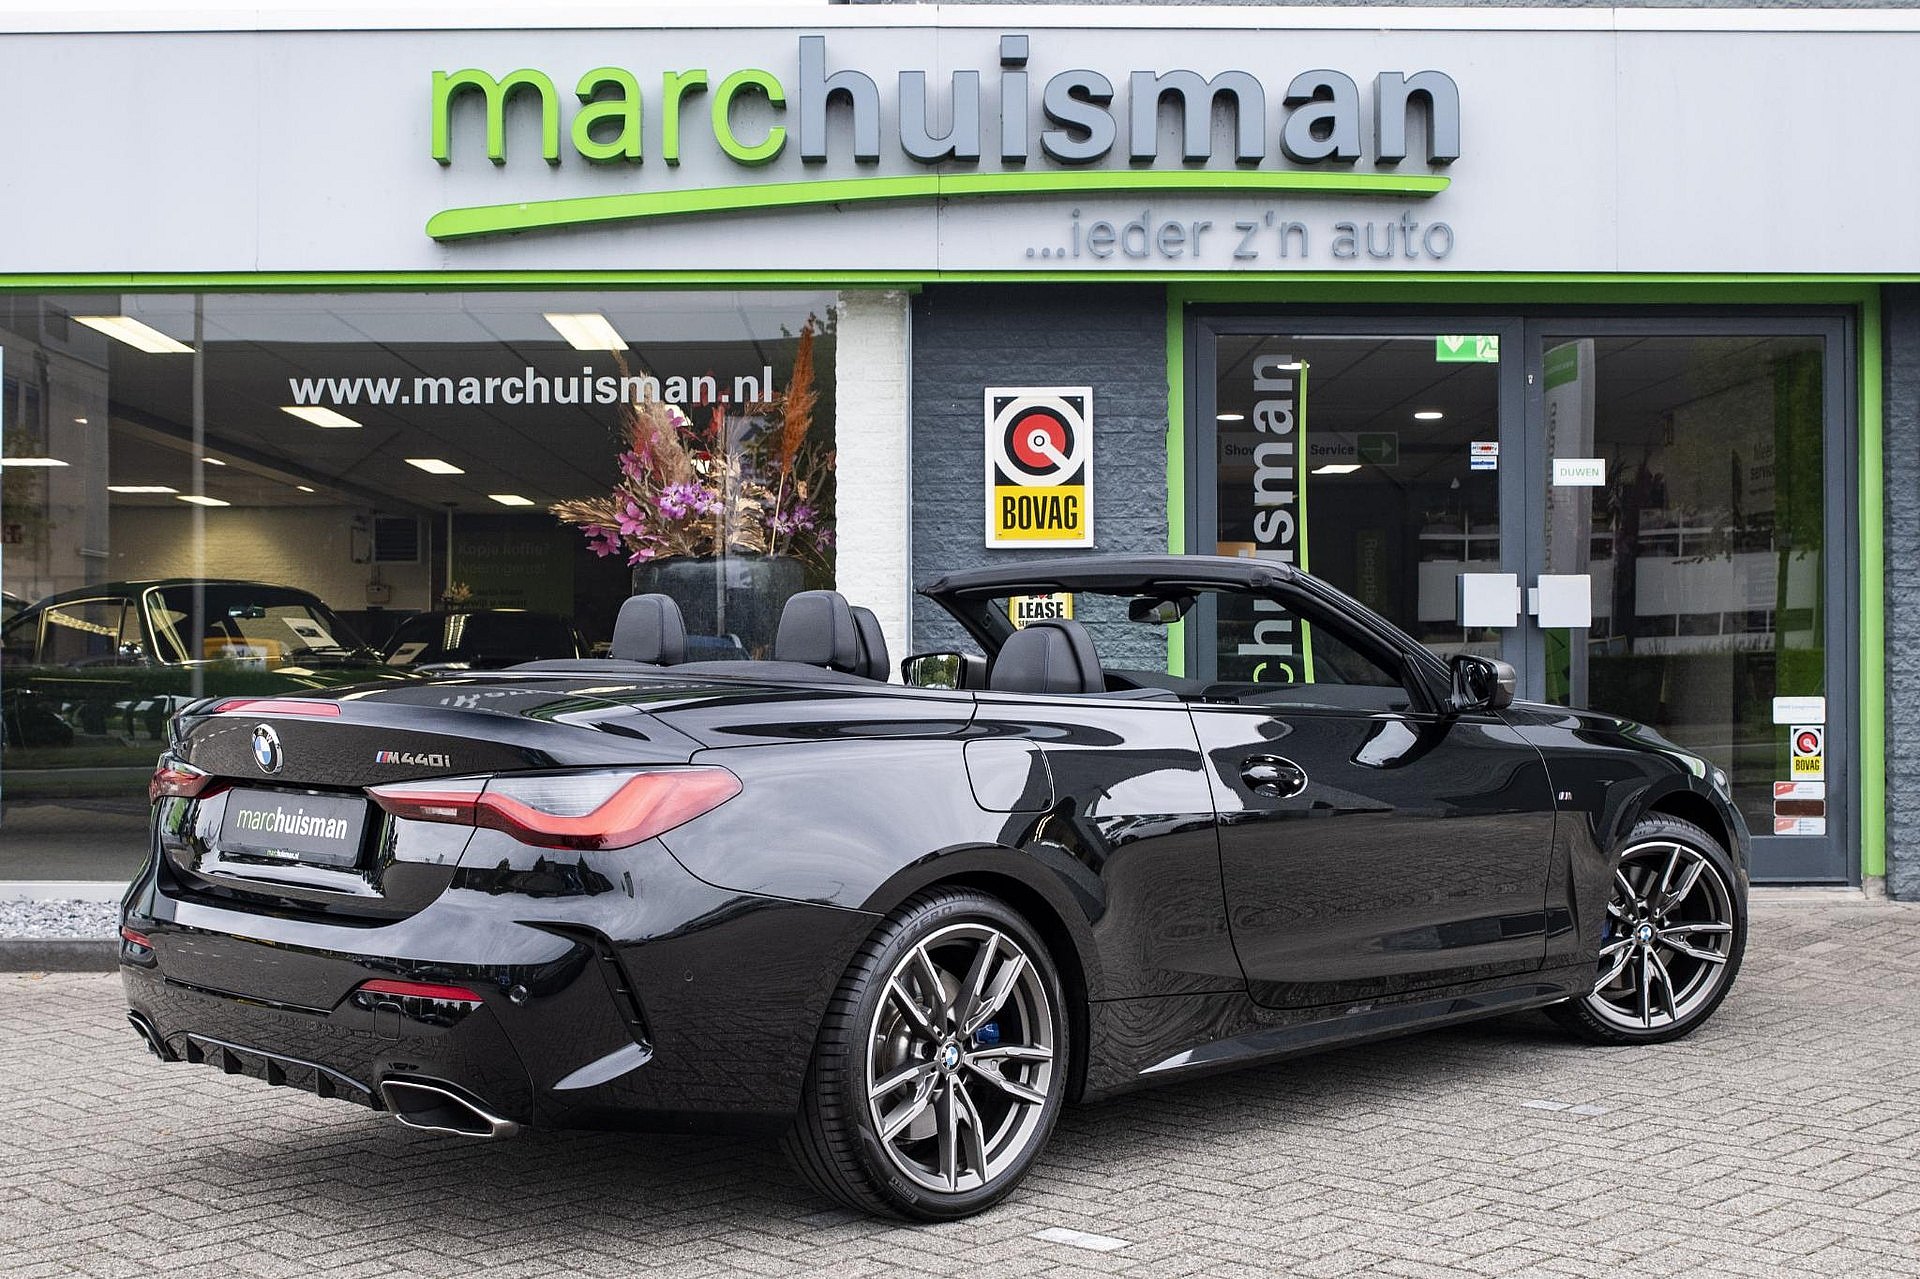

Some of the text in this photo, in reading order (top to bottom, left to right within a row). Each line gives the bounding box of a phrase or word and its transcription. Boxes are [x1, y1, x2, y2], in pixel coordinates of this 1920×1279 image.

[431, 34, 1461, 166] marchuisman
[1232, 210, 1310, 258] z'n
[1331, 209, 1455, 258] auto
[289, 366, 772, 404] www.marchuisman.nl
[1310, 443, 1354, 456] Service
[1560, 467, 1599, 477] DUWEN
[1002, 495, 1078, 530] BOVAG
[1018, 601, 1063, 618] LEASE
[1795, 759, 1820, 771] BOVAG
[236, 806, 348, 840] marchuisman
